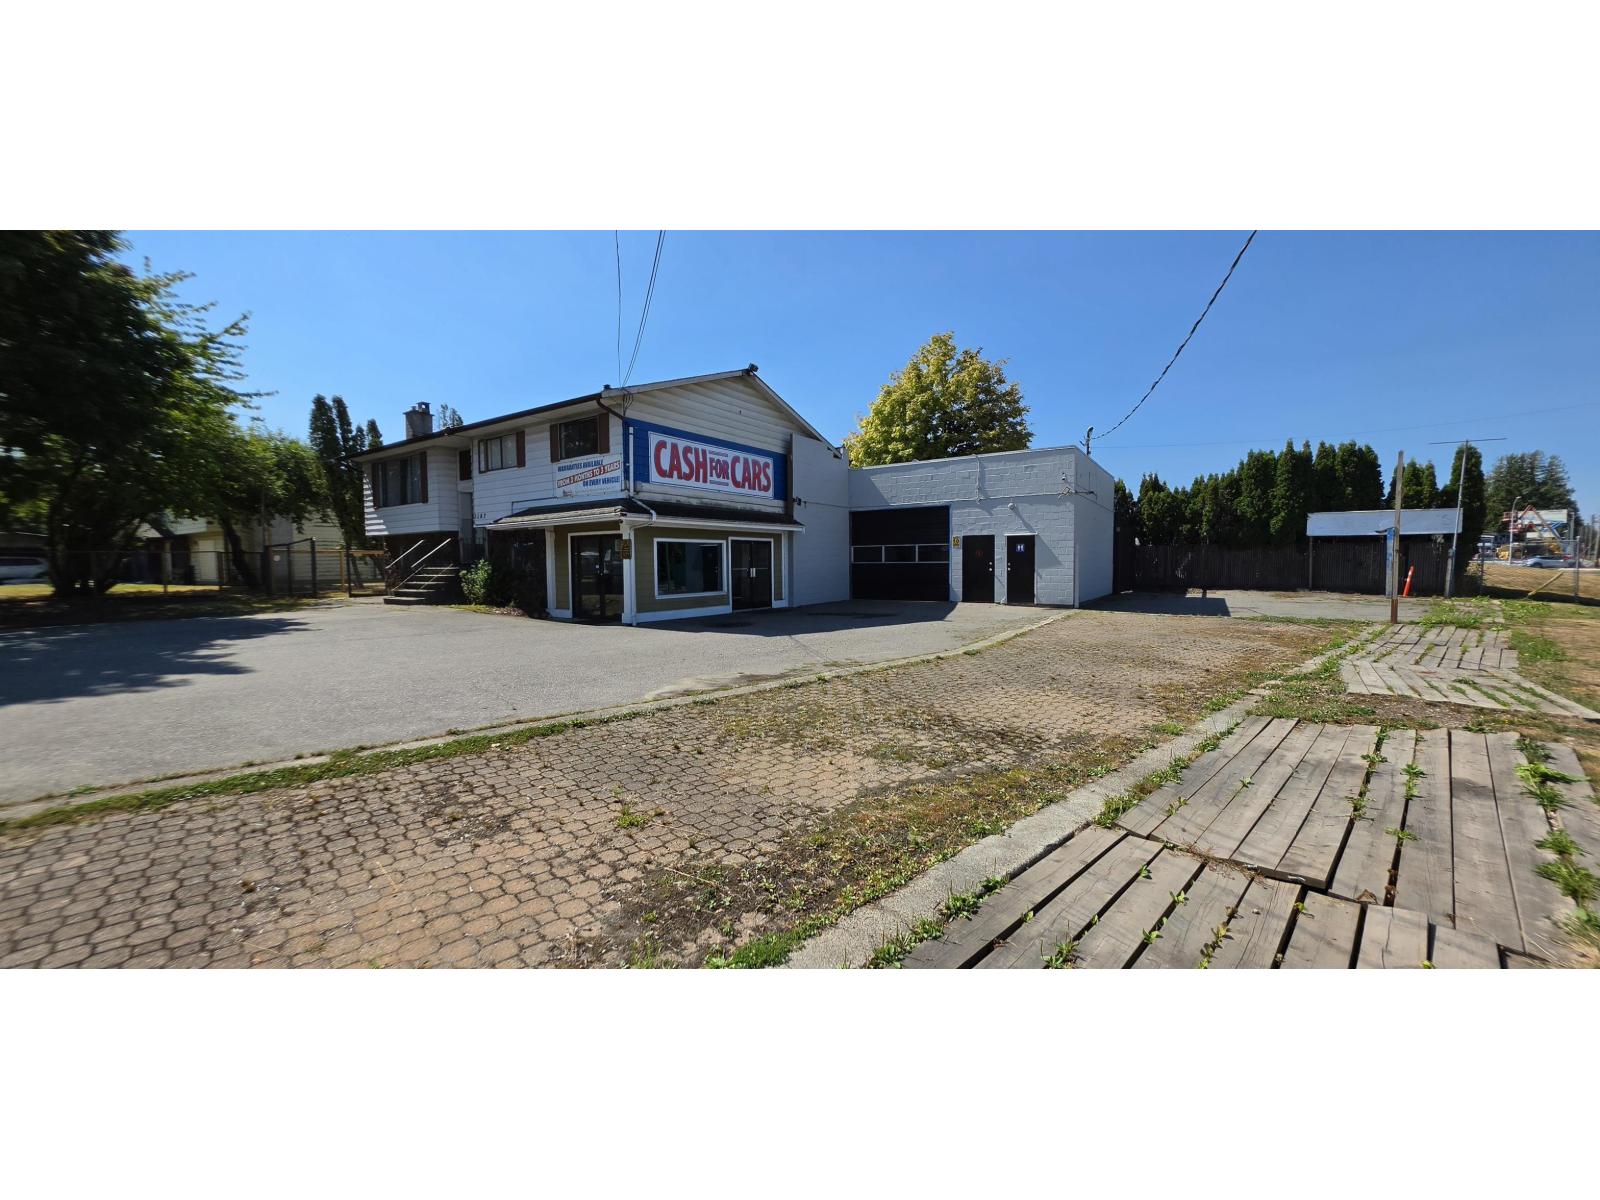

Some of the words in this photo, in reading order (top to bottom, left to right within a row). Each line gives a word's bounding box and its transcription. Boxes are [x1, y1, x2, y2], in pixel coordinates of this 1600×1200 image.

[557, 477, 570, 488] FROM
[574, 470, 593, 482] MONTHS
[593, 468, 600, 477] TO
[604, 461, 620, 472] YEARS
[654, 439, 708, 484] CASH
[709, 457, 730, 481] FOR
[730, 455, 772, 493] CARS
